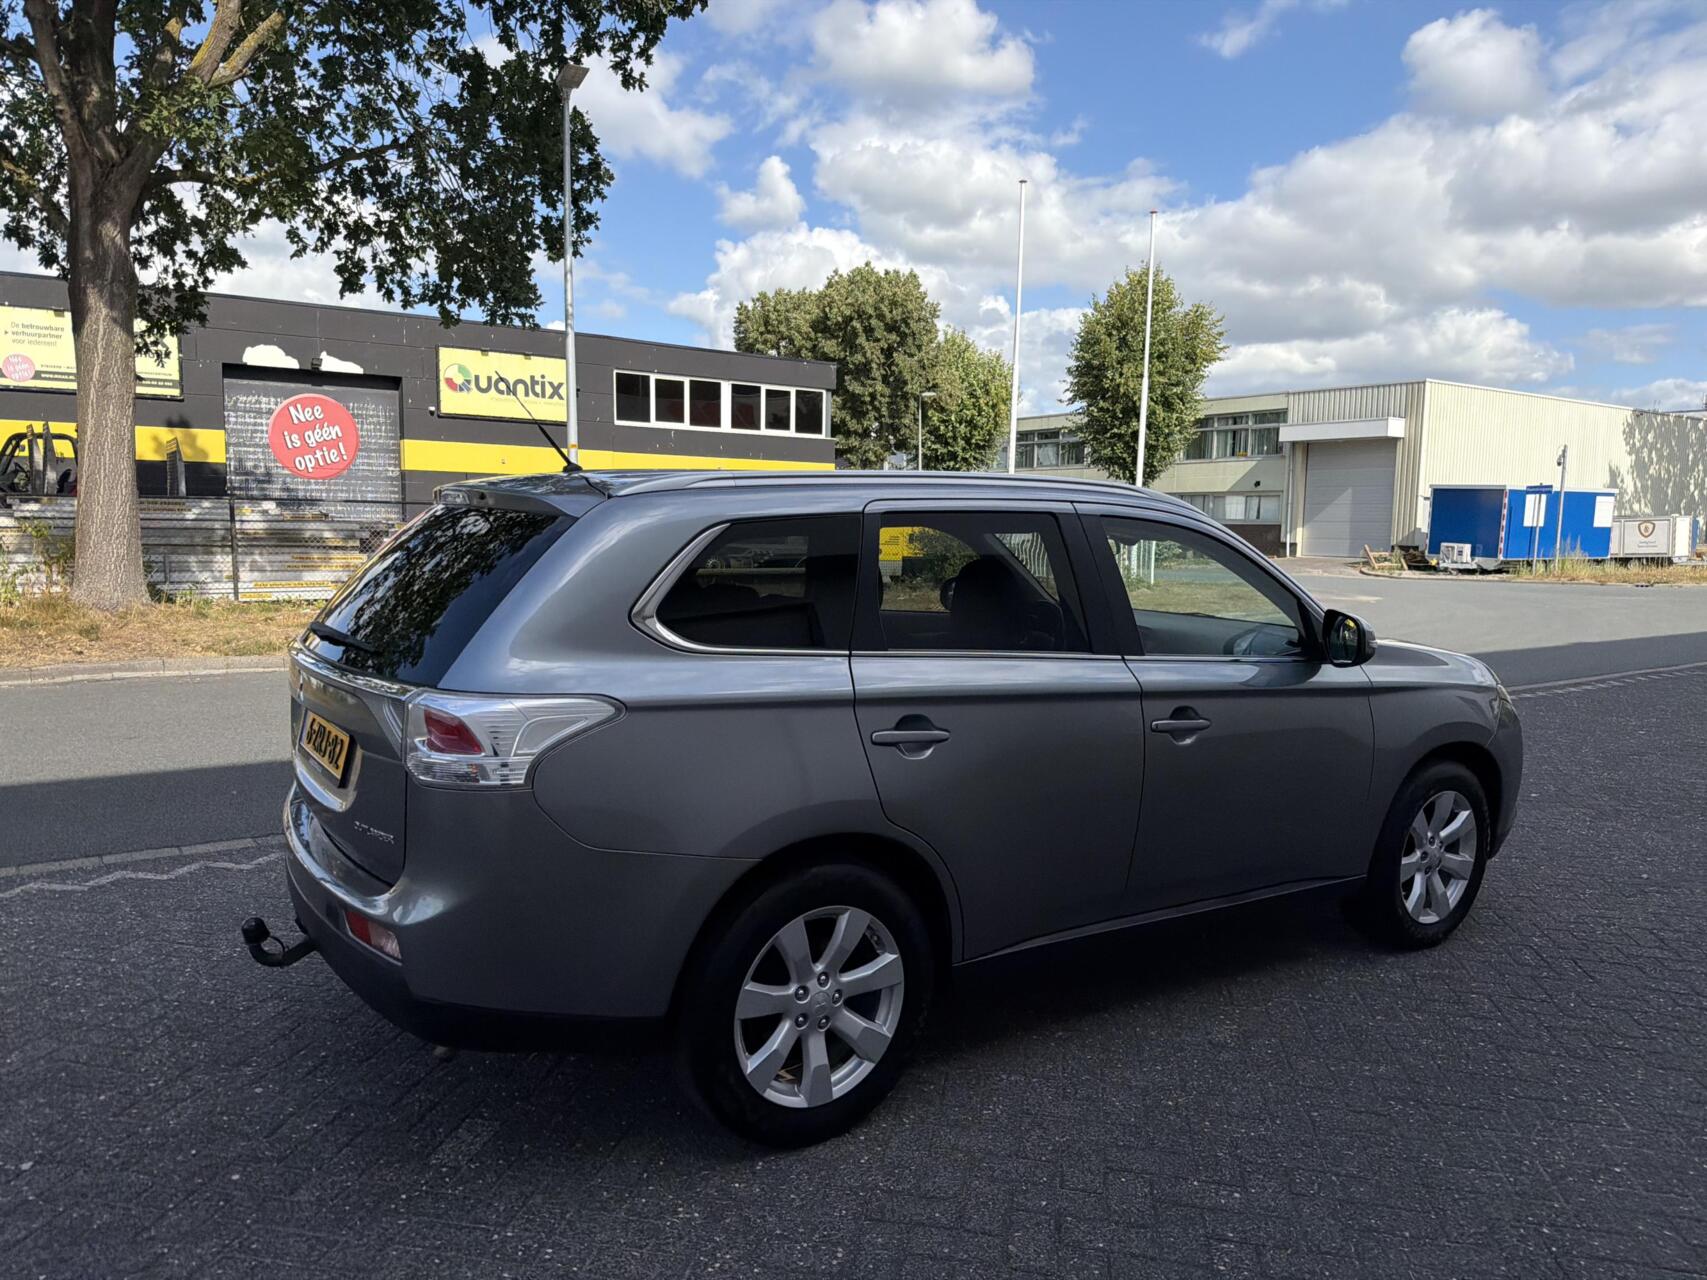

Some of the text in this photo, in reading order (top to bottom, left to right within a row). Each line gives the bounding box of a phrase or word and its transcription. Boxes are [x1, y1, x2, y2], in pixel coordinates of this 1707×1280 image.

[444, 363, 565, 400] Quantix
[288, 403, 324, 425] Nee
[283, 421, 343, 449] is géén
